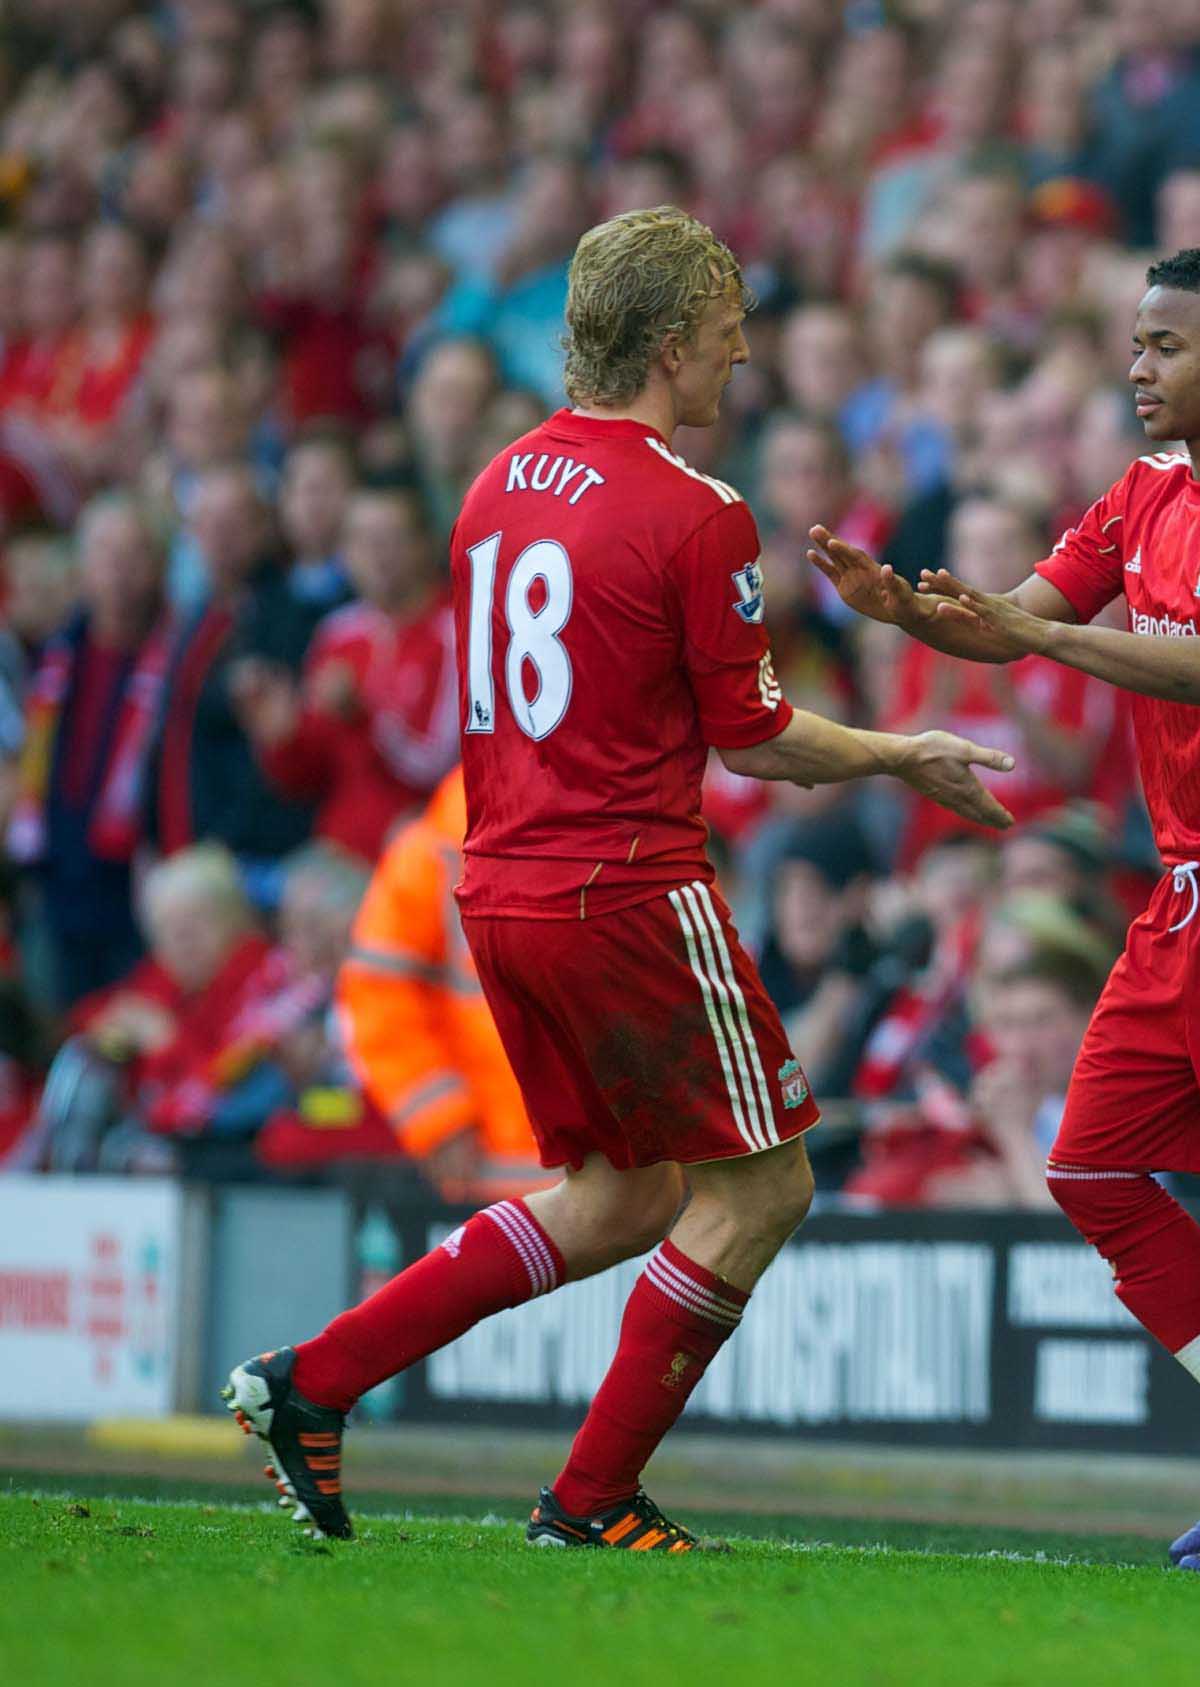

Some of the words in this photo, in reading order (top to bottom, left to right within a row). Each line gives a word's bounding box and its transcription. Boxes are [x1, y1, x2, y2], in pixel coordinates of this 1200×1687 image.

[505, 453, 605, 506] KUYT
[464, 530, 574, 742] 18
[1129, 604, 1197, 637] tandard
